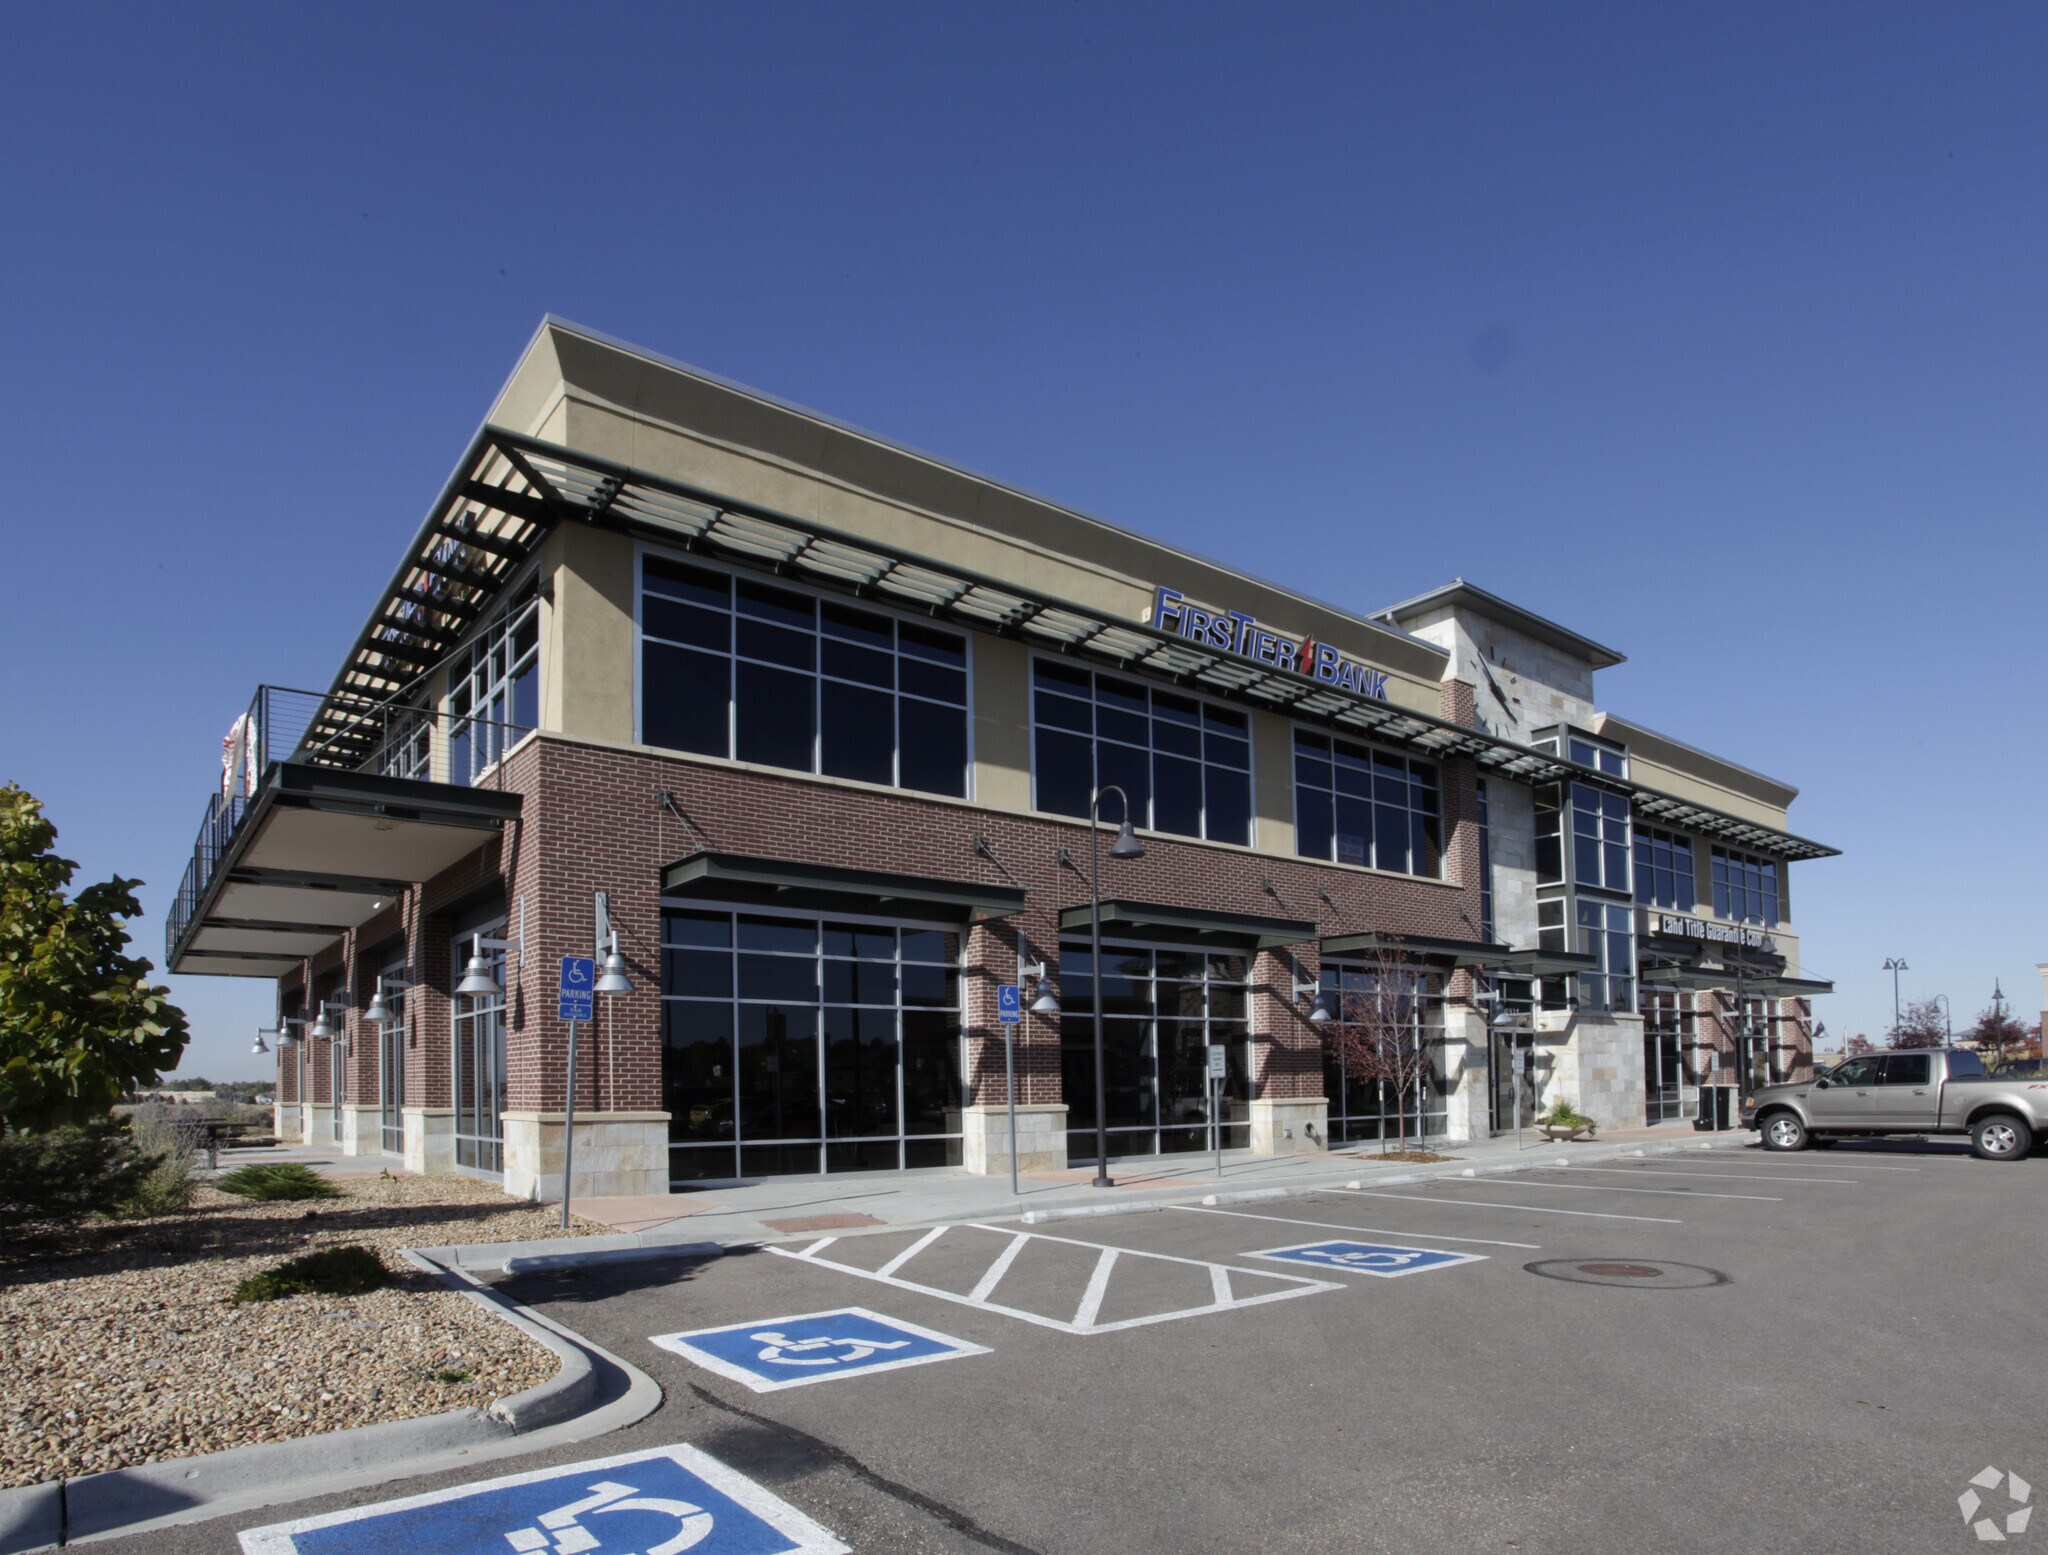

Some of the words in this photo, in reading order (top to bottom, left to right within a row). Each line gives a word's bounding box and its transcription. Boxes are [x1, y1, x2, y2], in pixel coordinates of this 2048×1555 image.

[1663, 915, 1684, 935] Land
[1685, 919, 1705, 939] Title
[562, 989, 591, 1000] PARKING
